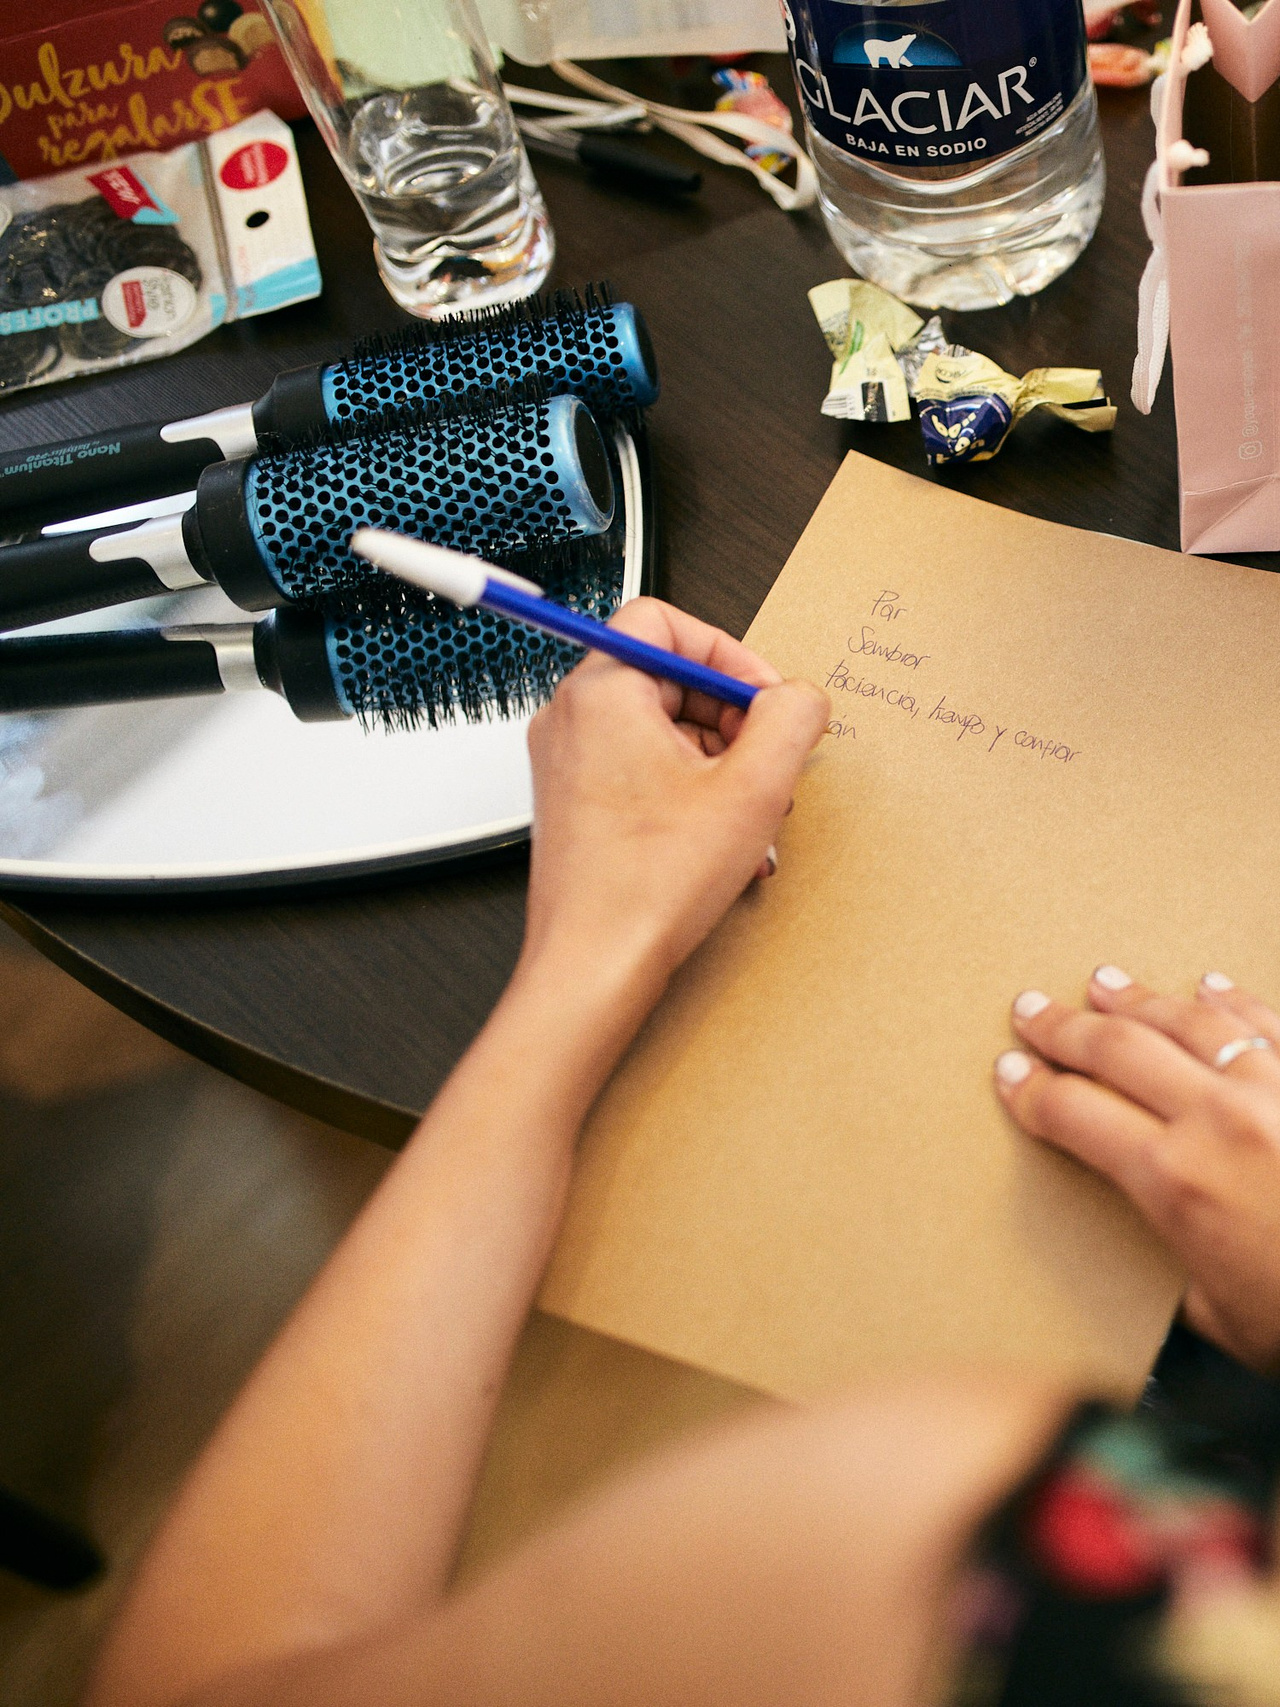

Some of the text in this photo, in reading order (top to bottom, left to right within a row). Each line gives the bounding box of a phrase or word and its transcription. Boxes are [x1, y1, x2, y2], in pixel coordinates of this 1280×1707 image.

[845, 132, 988, 157] BAJA EN SODIO
[77, 442, 121, 459] Nano
